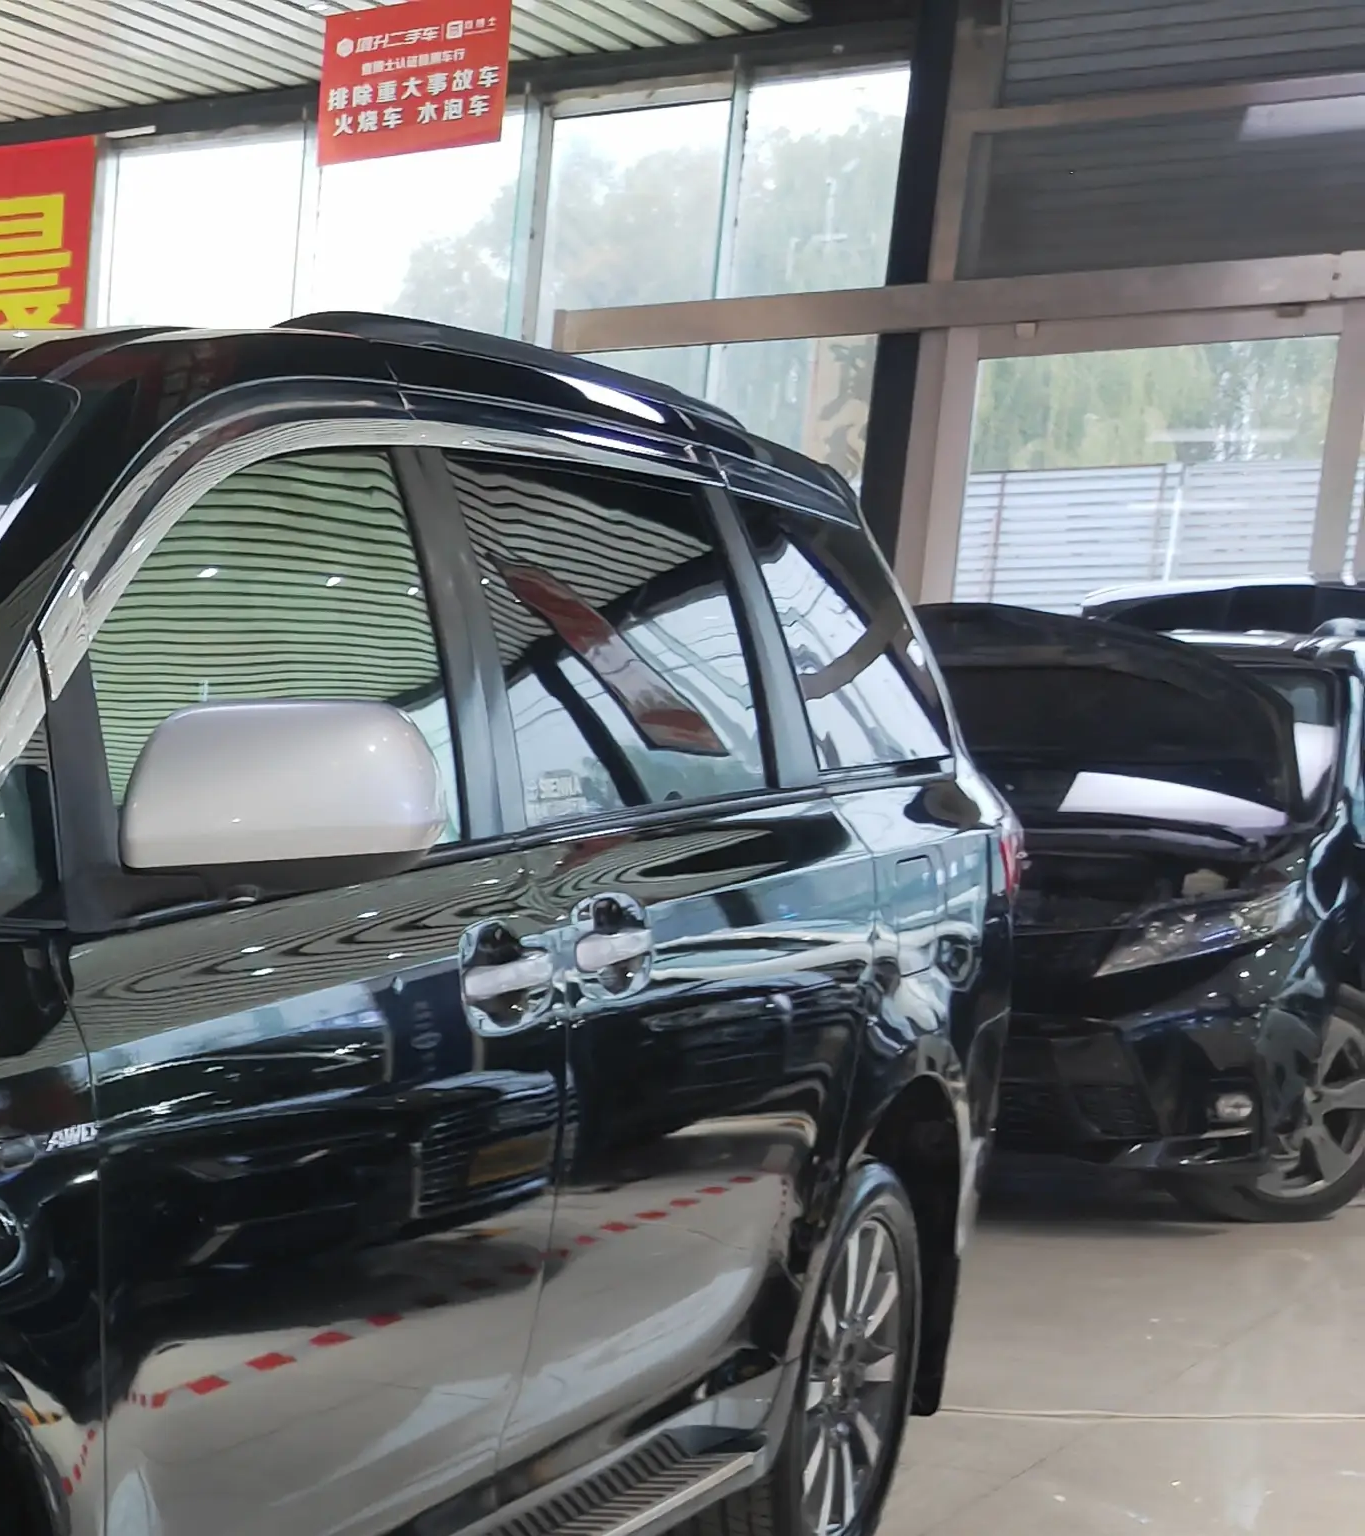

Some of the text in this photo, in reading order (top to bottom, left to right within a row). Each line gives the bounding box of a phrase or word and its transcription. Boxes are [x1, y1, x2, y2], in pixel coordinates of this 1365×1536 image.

[328, 65, 501, 112] 排除重大事故车
[332, 94, 491, 137] 火烧车 水泡车
[45, 1122, 99, 1152] AWD
